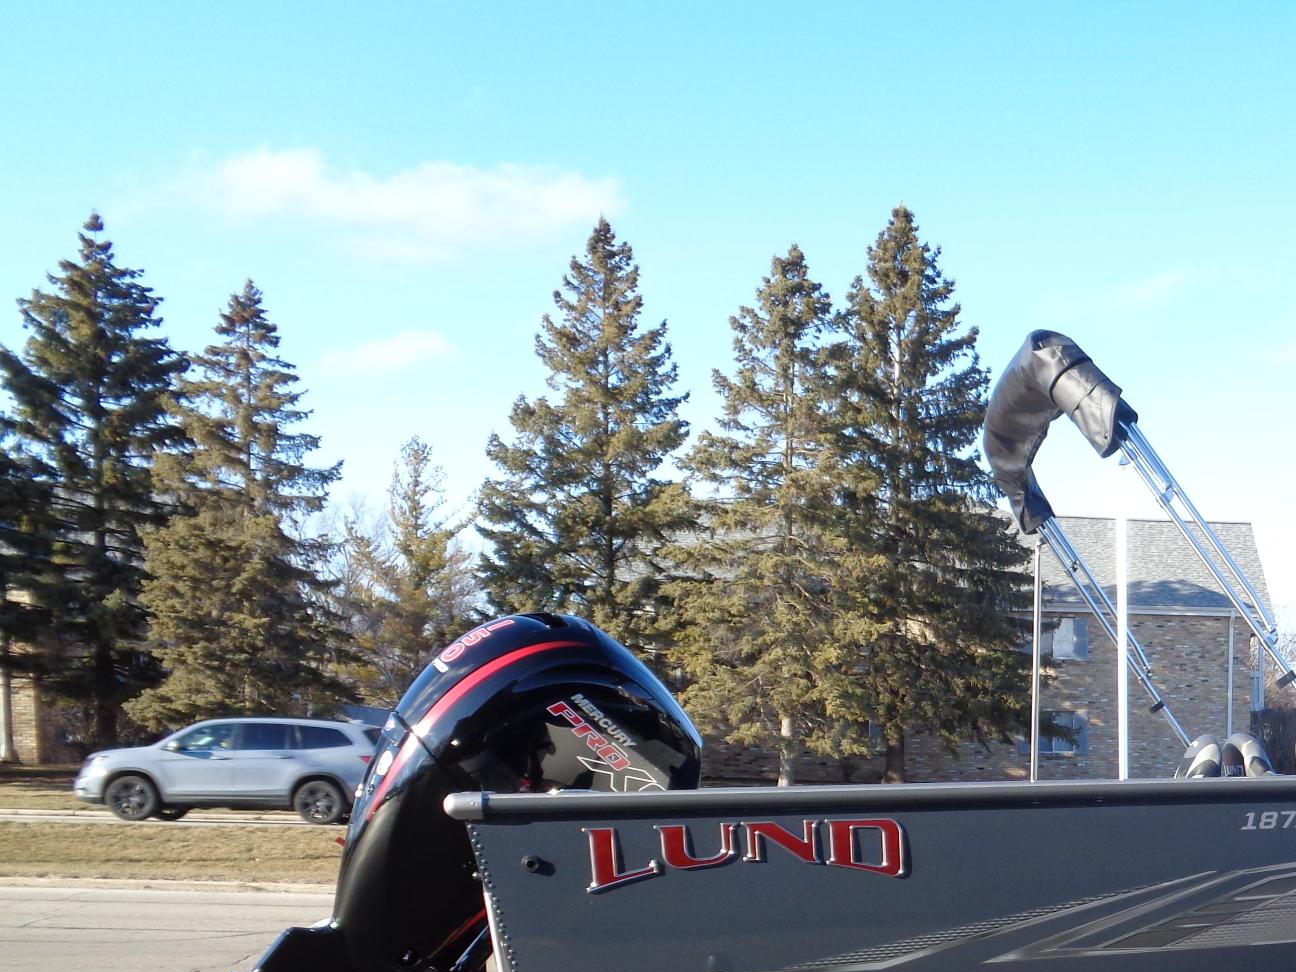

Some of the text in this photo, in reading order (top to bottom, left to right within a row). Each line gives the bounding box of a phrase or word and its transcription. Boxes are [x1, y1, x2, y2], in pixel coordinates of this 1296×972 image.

[440, 619, 515, 663] 150
[546, 701, 631, 771] PRO
[570, 693, 637, 747] MERCURY
[581, 817, 905, 894] LUND
